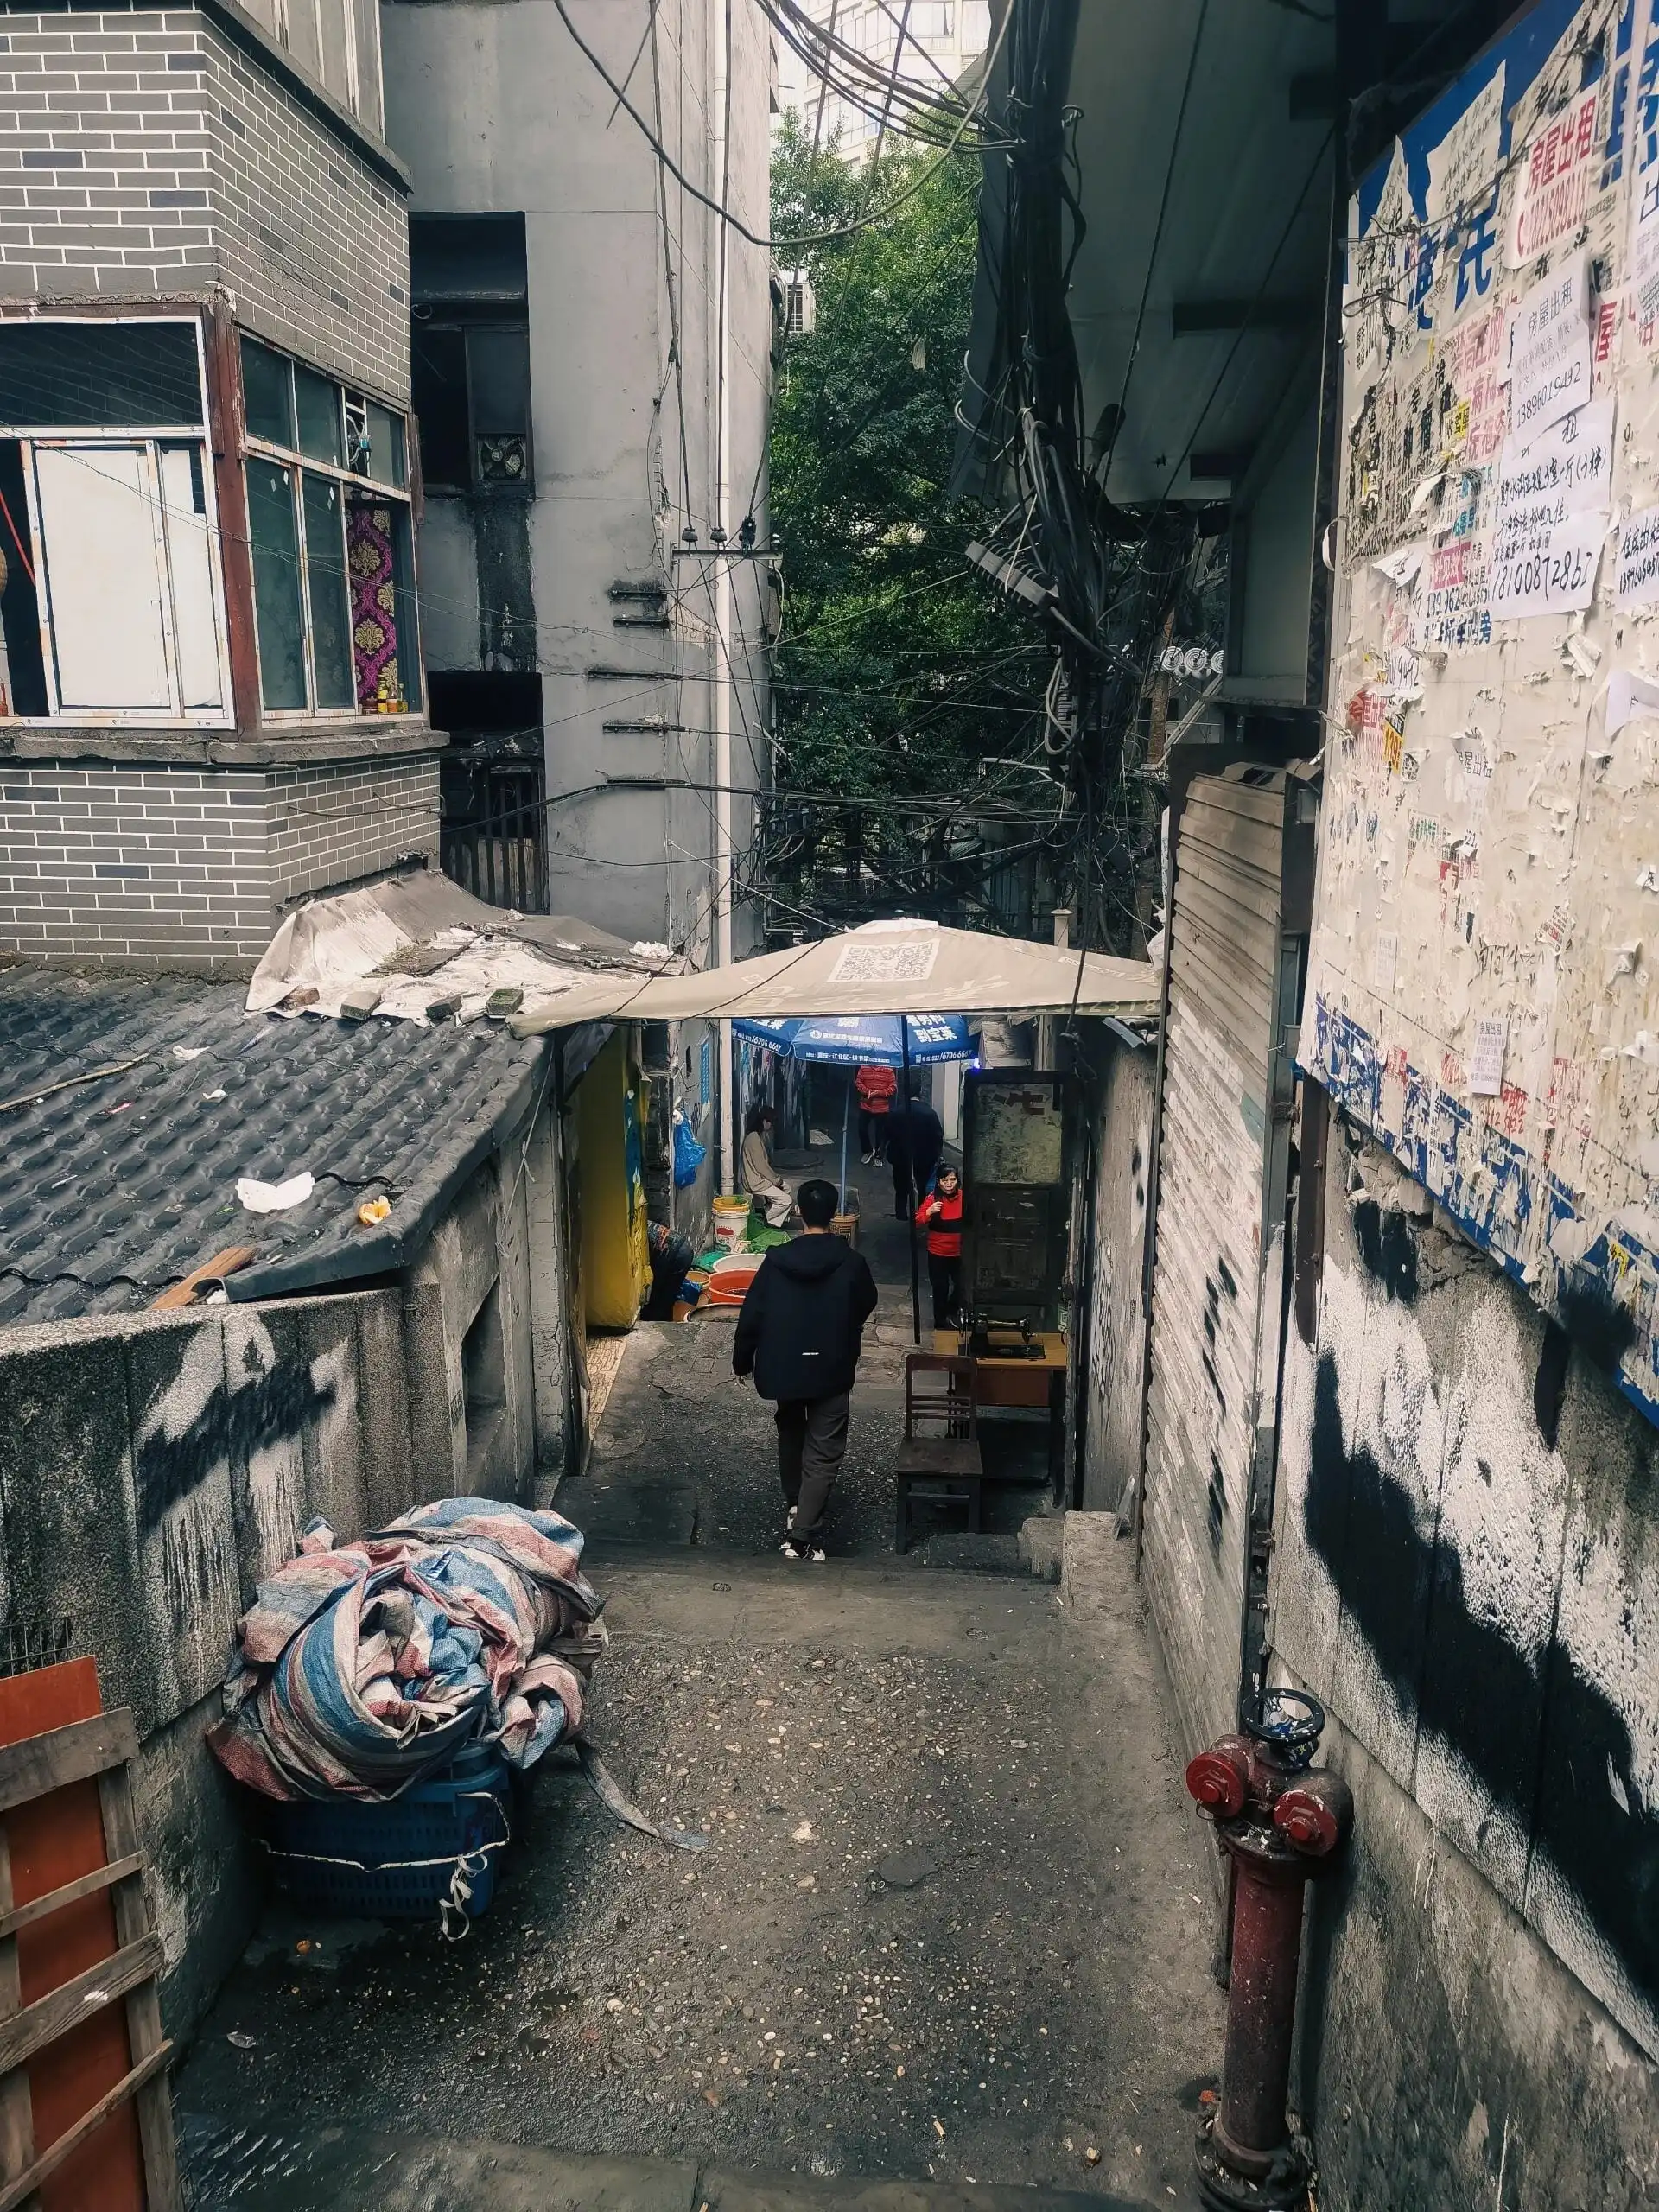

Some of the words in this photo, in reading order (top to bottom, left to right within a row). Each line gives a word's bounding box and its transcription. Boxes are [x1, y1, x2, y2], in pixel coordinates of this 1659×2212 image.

[1524, 94, 1597, 200] 房屋出租
[1528, 276, 1573, 341] 房屋出租
